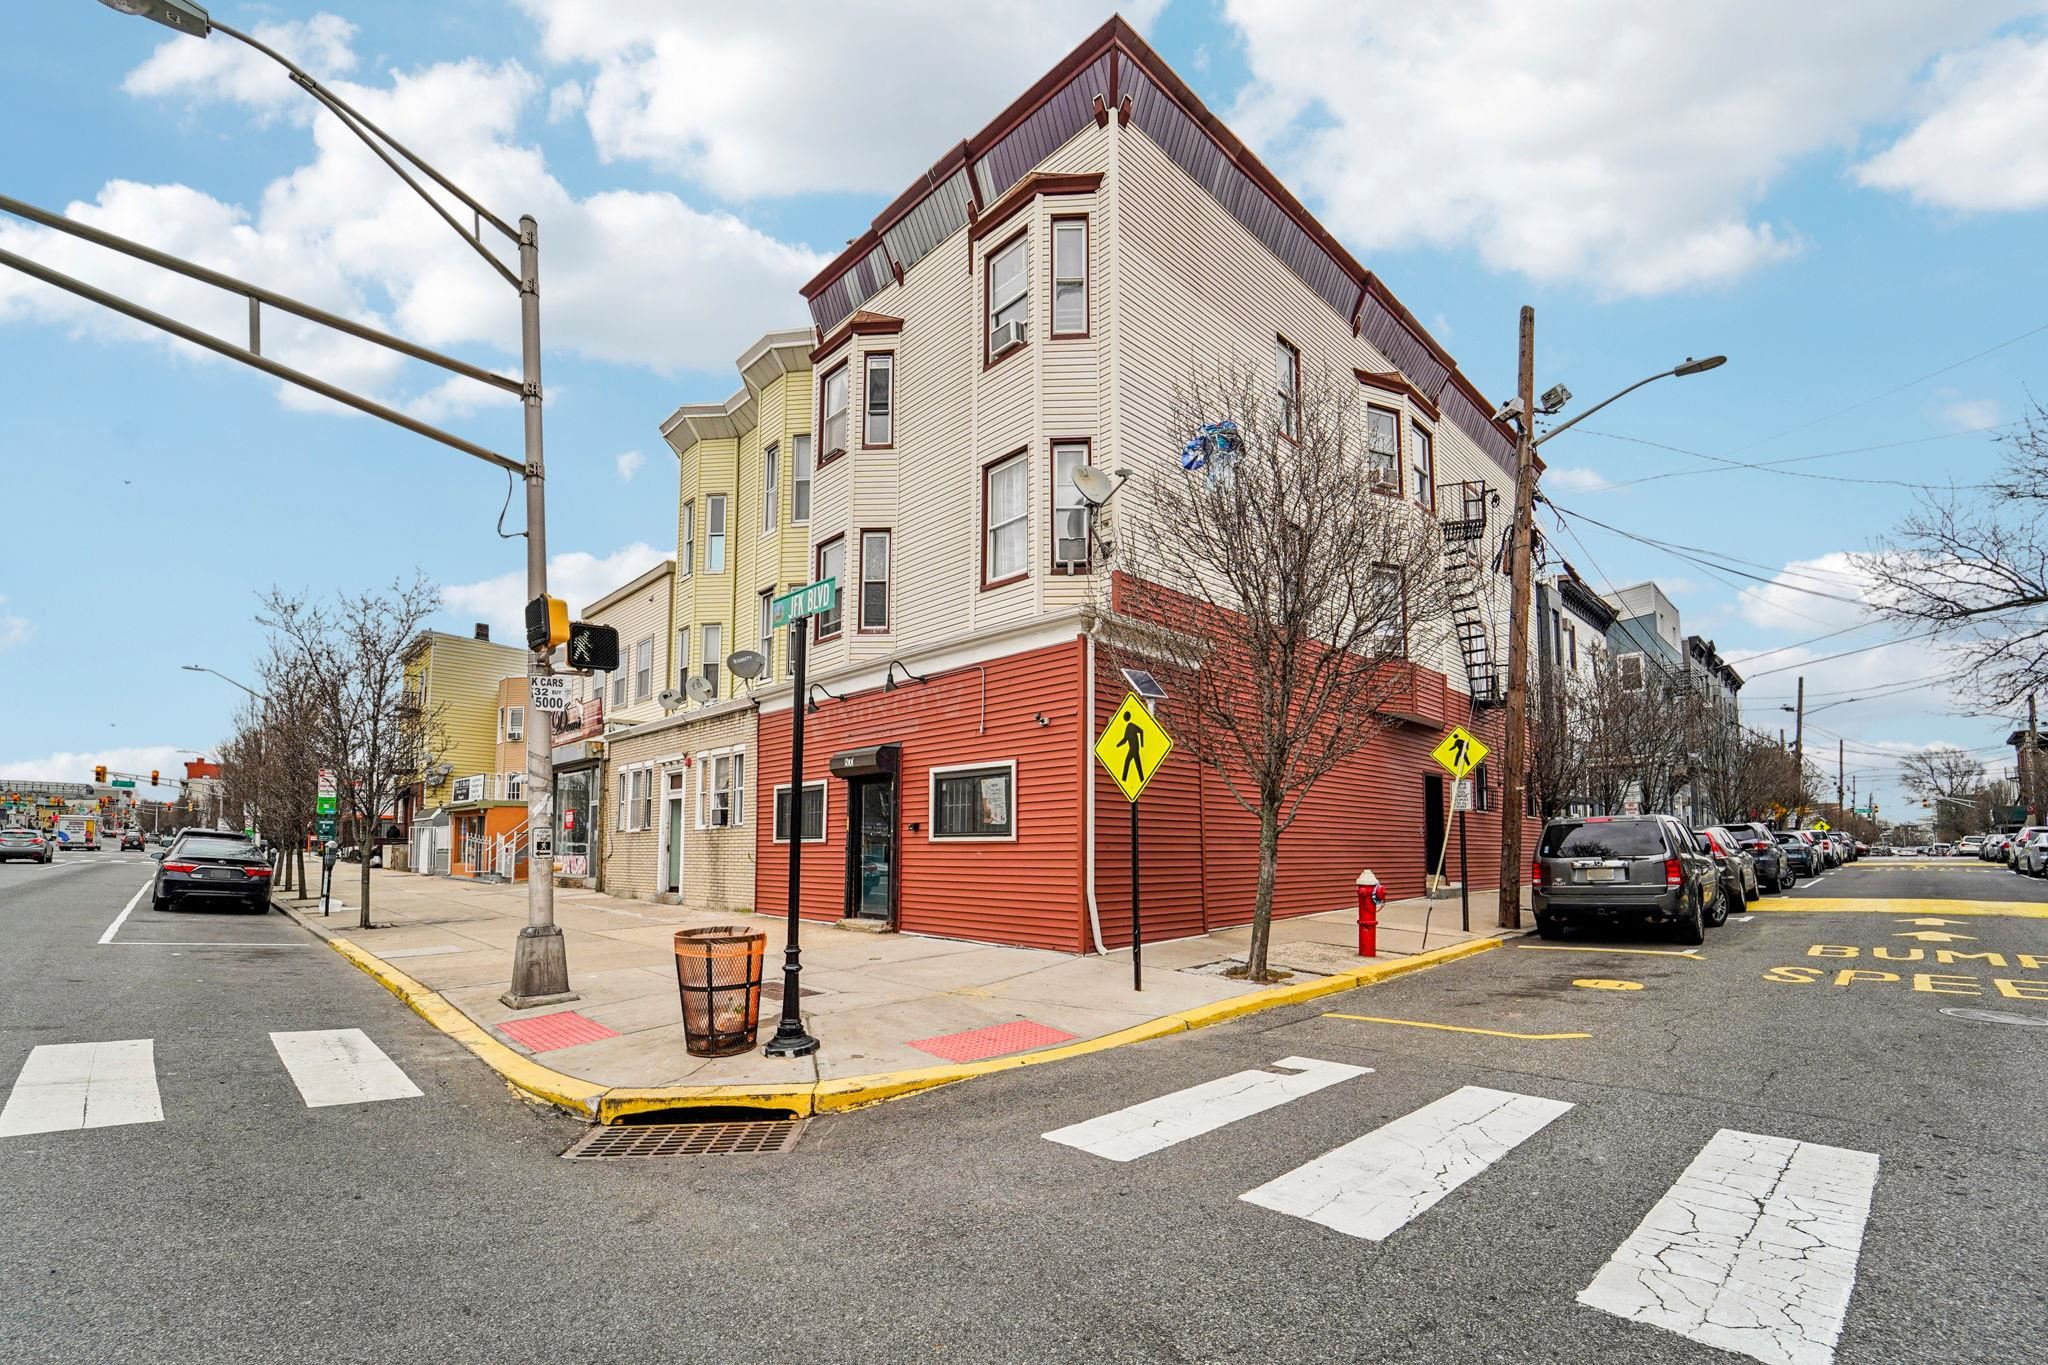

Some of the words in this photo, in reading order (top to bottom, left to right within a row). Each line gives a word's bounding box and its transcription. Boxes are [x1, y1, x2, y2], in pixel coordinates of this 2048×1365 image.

[788, 593, 804, 619] JFK
[807, 583, 829, 612] BLVD
[531, 677, 538, 686] K
[540, 678, 564, 688] CARS
[535, 697, 563, 709] 5000
